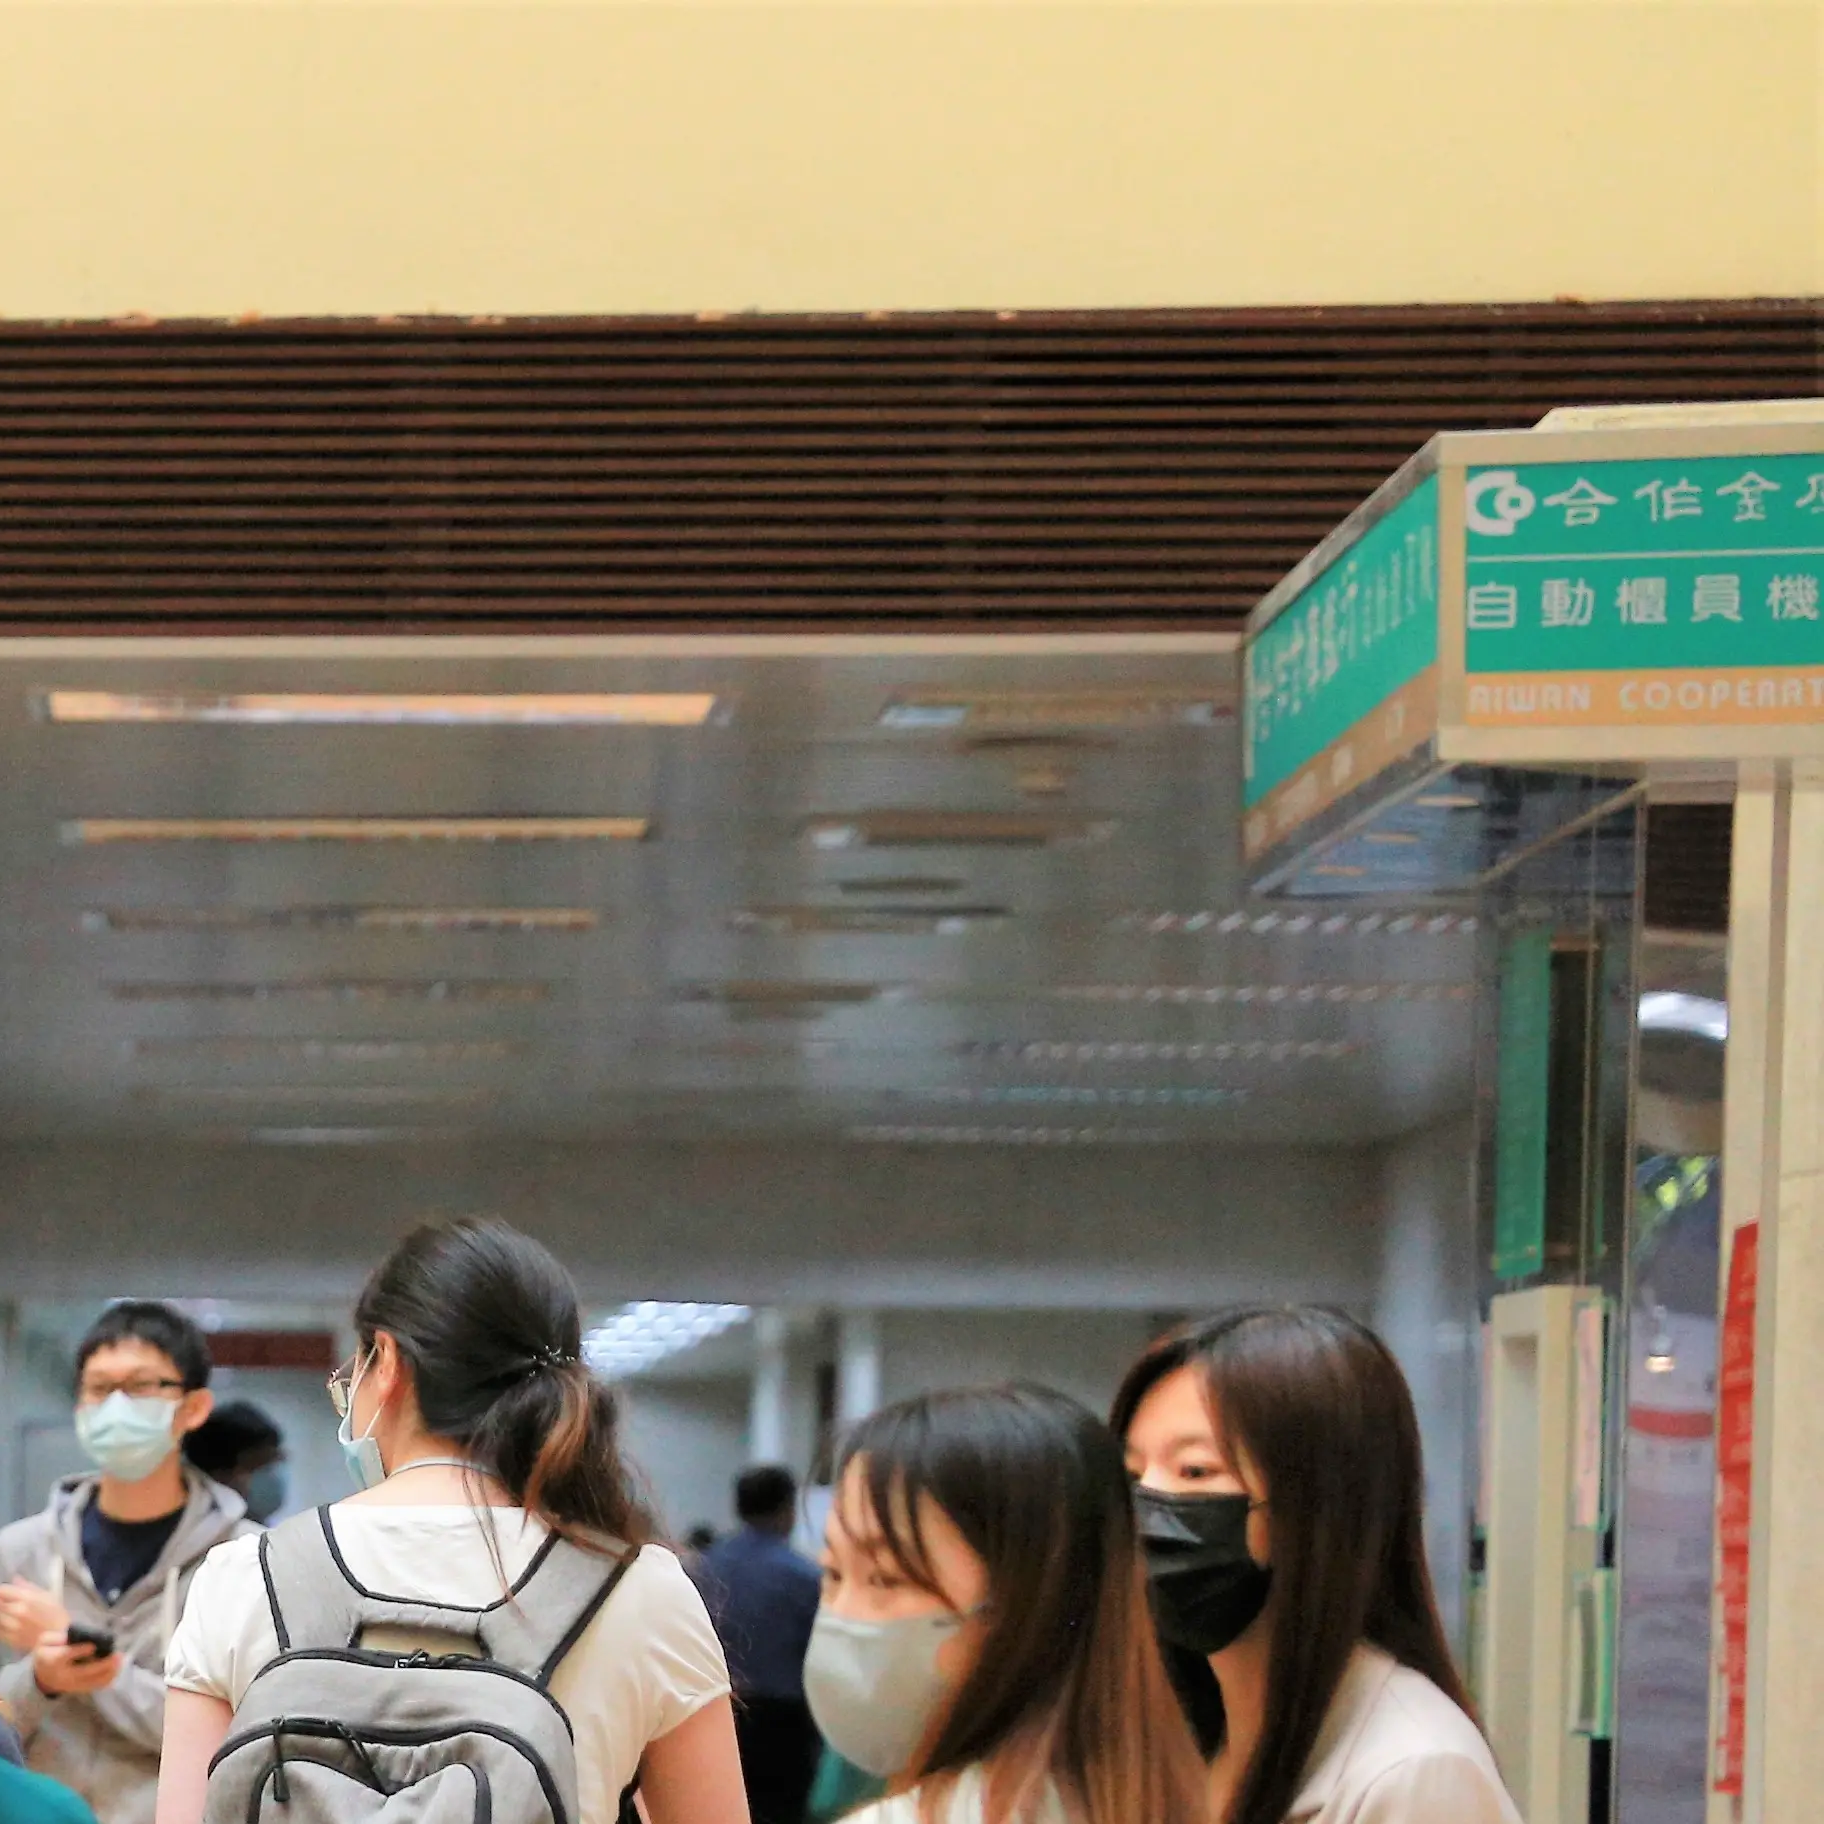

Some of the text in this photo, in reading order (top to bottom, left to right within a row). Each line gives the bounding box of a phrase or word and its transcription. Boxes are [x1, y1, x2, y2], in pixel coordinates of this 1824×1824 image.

[1468, 573, 1821, 630] 自動櫃員機
